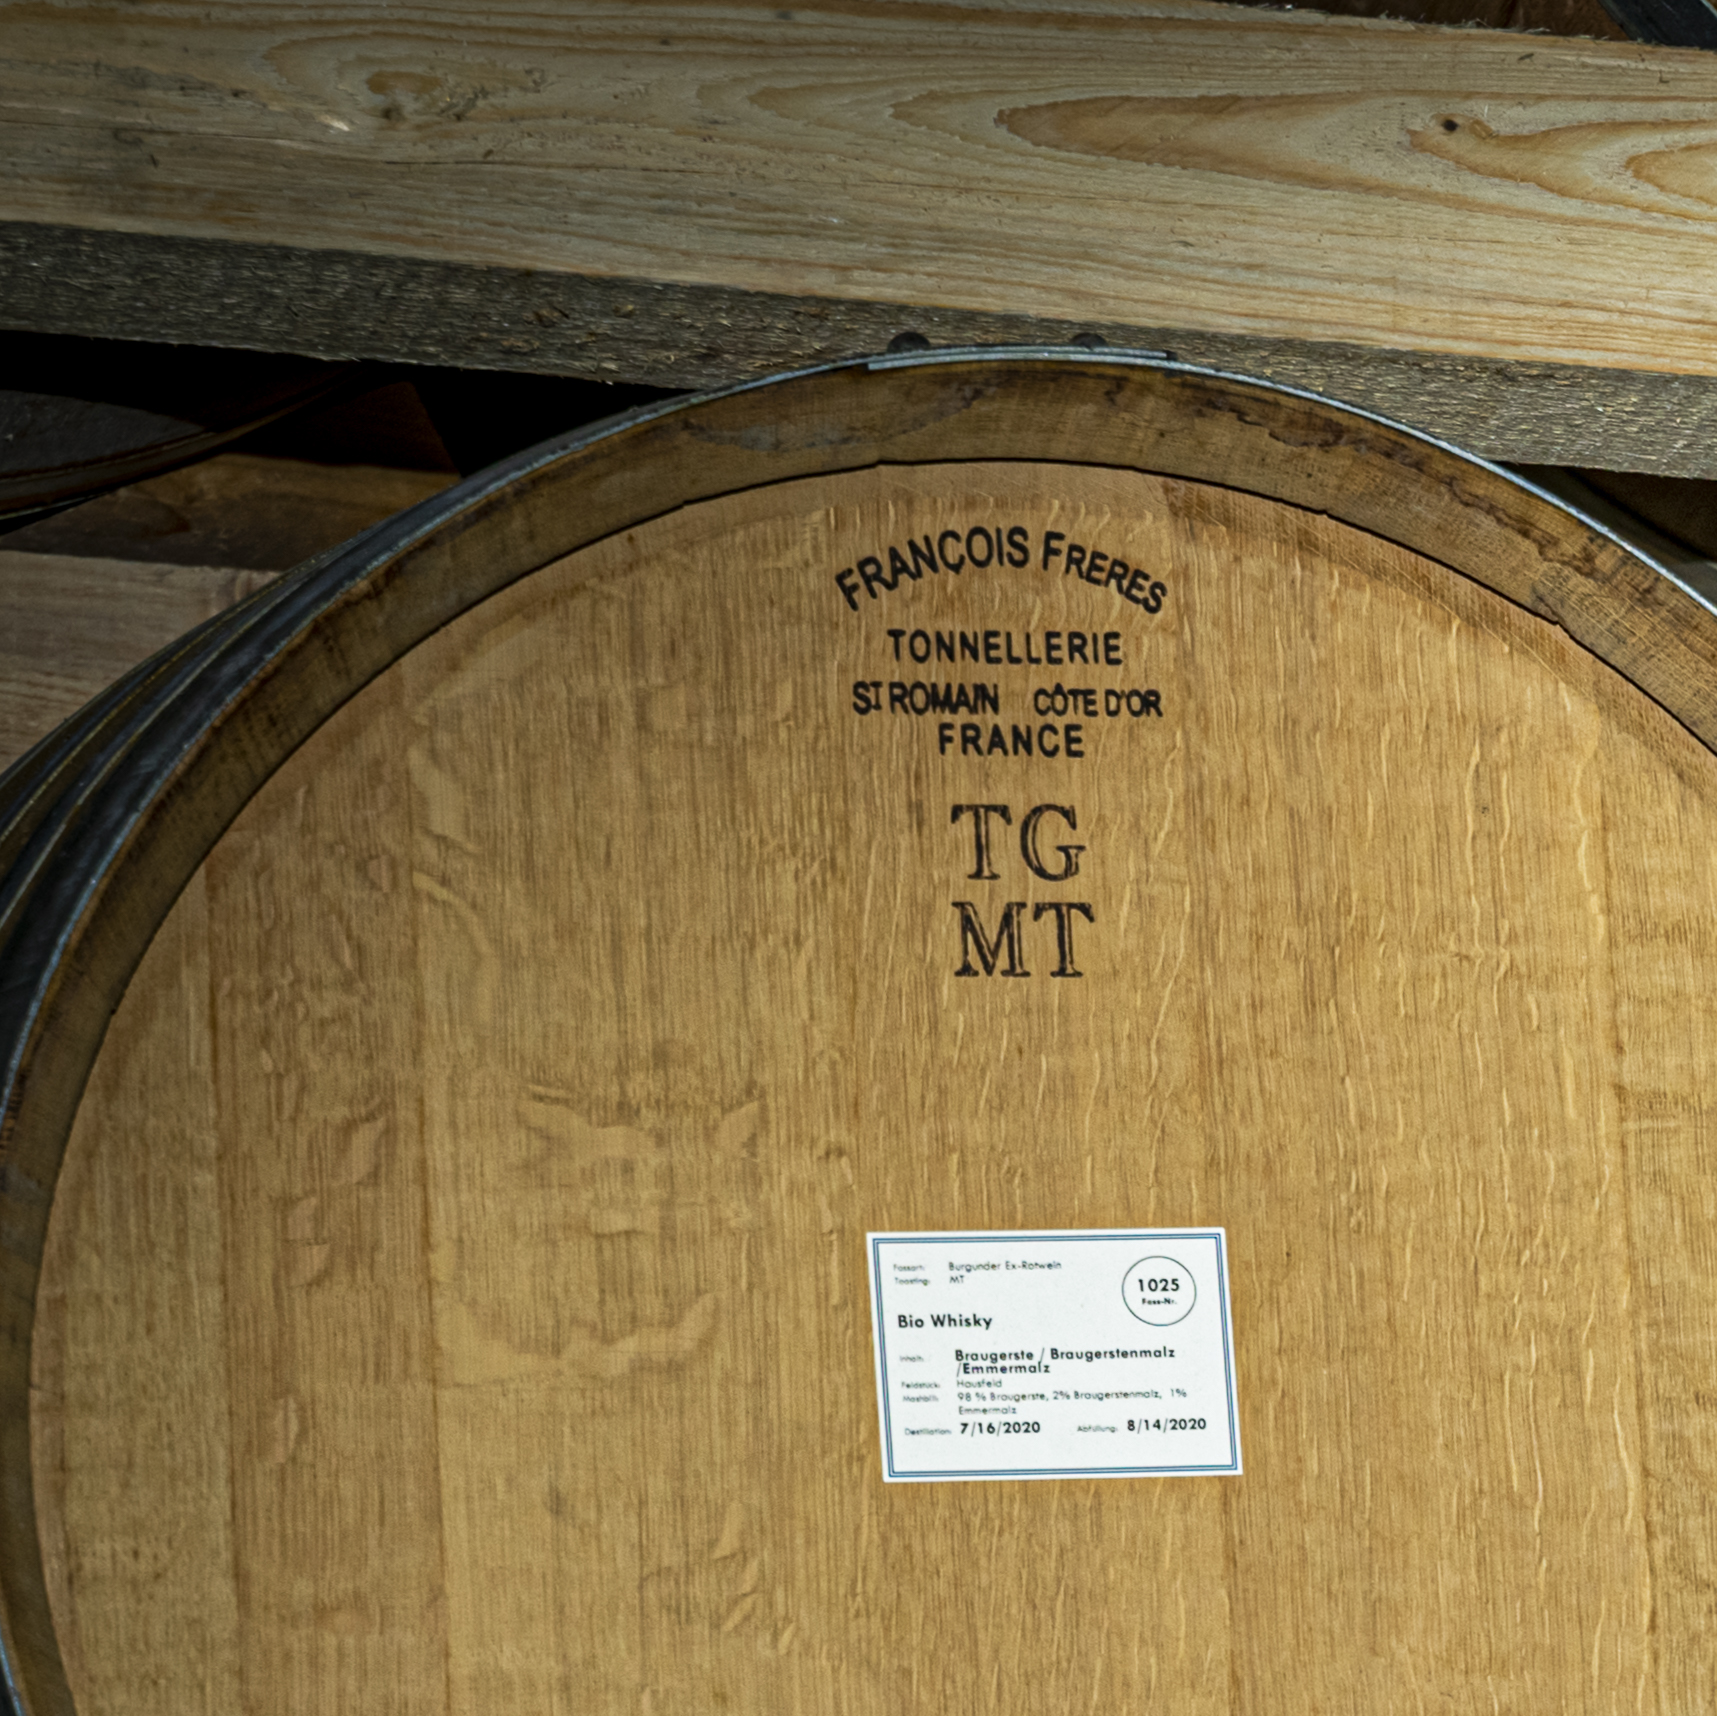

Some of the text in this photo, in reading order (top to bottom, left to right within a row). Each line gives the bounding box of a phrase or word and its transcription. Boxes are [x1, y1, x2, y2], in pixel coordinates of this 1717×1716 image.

[1042, 530, 1168, 614] FRERES
[887, 628, 1123, 666] TONNELLERIE
[937, 722, 1085, 758] FRANCE
[950, 803, 1087, 882] TG
[950, 900, 1096, 979] MT
[948, 1261, 1001, 1273] Burgunder
[1005, 1259, 1062, 1271] Ex-Rotwein
[949, 1275, 966, 1284] MT
[1138, 1278, 1180, 1292] 1025
[897, 1313, 993, 1331] Bio Whisky
[955, 1349, 1034, 1364] Braugerste
[1050, 1345, 1176, 1363] Braugerstenmalz
[956, 1378, 1002, 1388] Hausfeld
[989, 1391, 1049, 1402] Braugerste,
[1052, 1390, 1071, 1401] 2%
[1073, 1389, 1163, 1401] Braugerstenmalz,
[1170, 1388, 1188, 1398] 1%
[958, 1405, 1017, 1415] Emmermalz
[960, 1421, 1041, 1437] 7/16/2020
[1127, 1418, 1207, 1434] 8/14/2020
